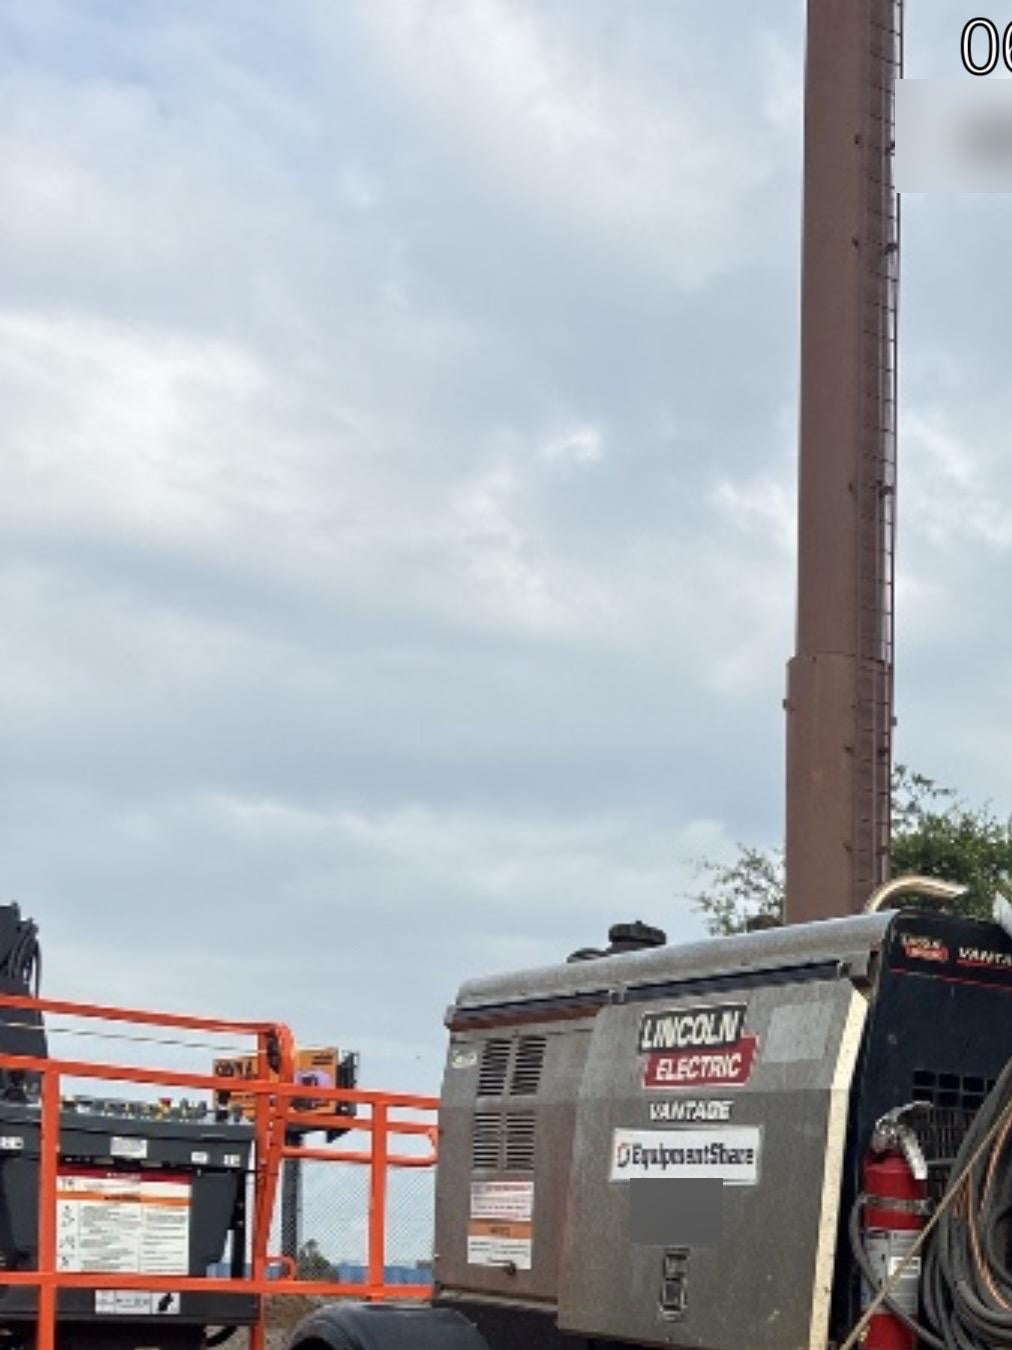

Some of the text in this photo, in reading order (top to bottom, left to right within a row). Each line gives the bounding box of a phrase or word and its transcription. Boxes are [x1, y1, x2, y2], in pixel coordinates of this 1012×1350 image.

[641, 1010, 740, 1048] LINCOLN
[655, 1051, 743, 1081] ELECTRIC
[649, 1100, 735, 1120] VANTAGE
[632, 1142, 754, 1170] EquipmentShare
